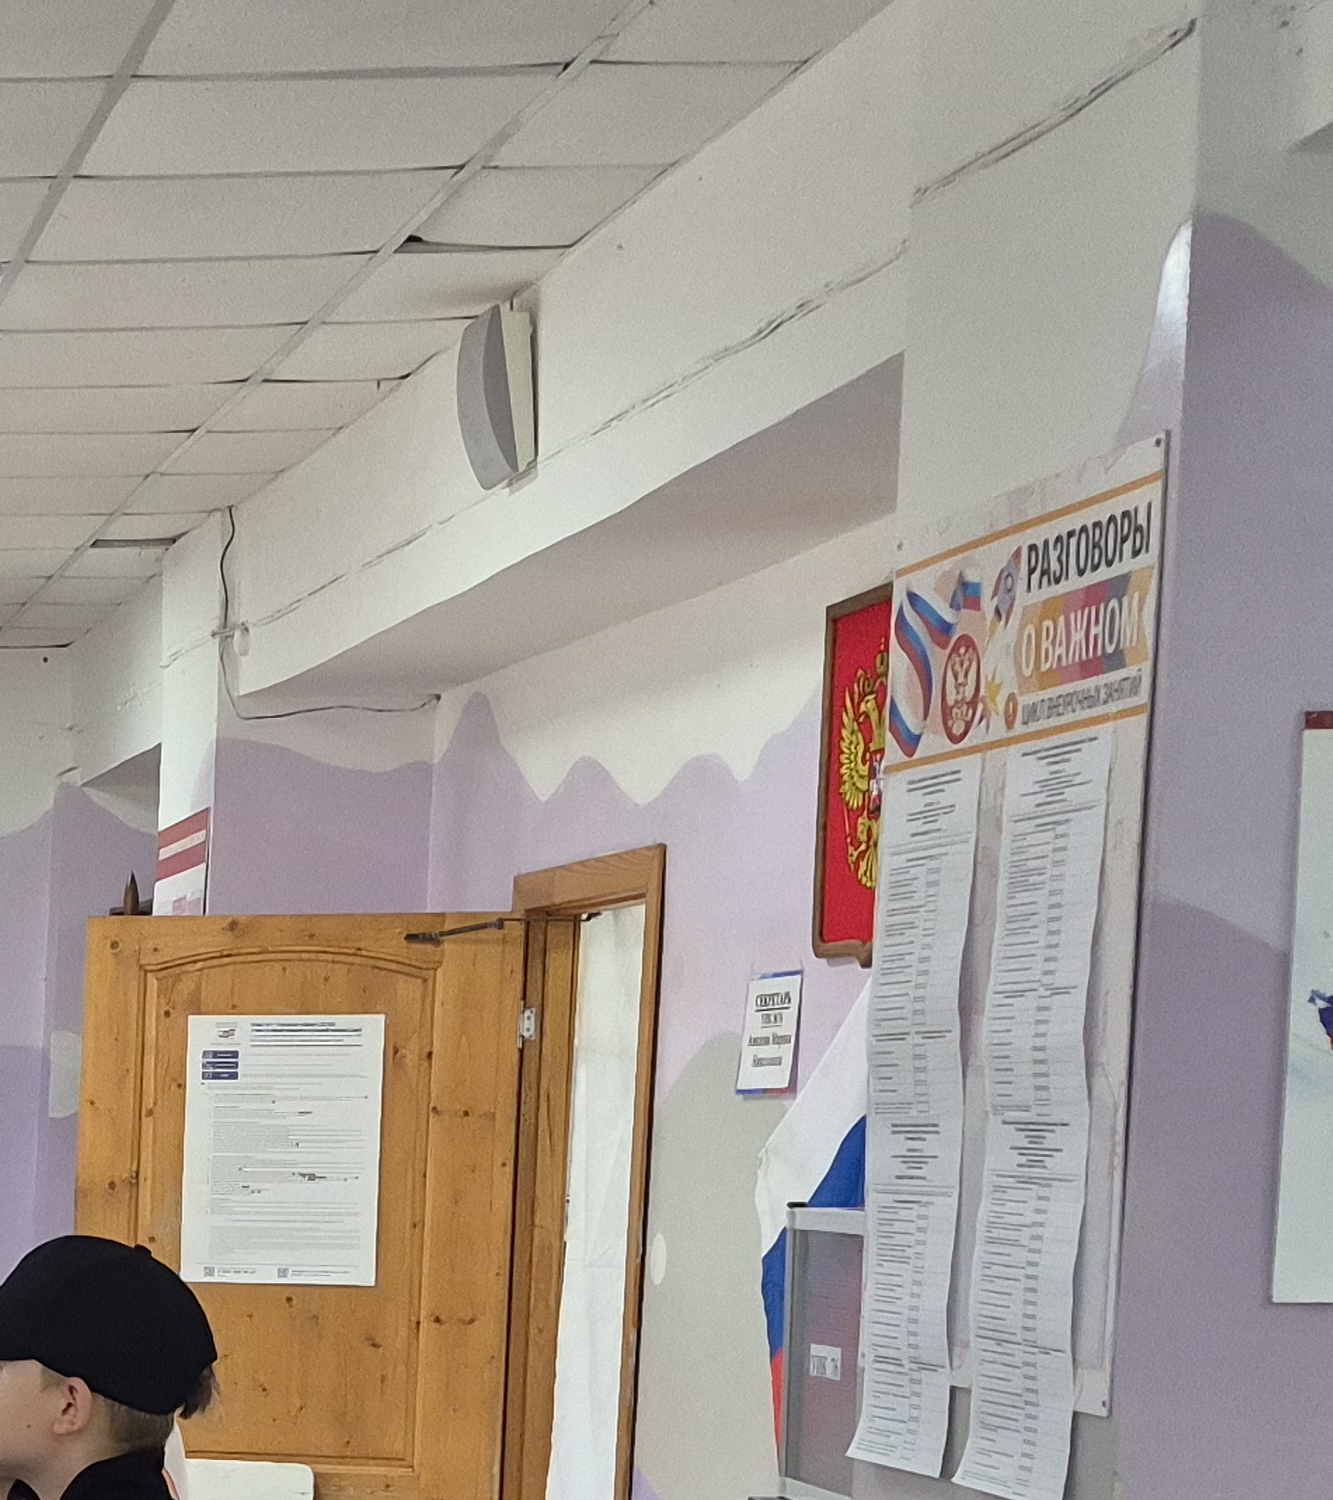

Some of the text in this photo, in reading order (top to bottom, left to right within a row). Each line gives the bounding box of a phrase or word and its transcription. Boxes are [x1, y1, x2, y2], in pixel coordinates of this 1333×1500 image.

[1026, 501, 1152, 593] РАЗГОВОРЫ
[1021, 593, 1140, 678] О ВАЖНОМ
